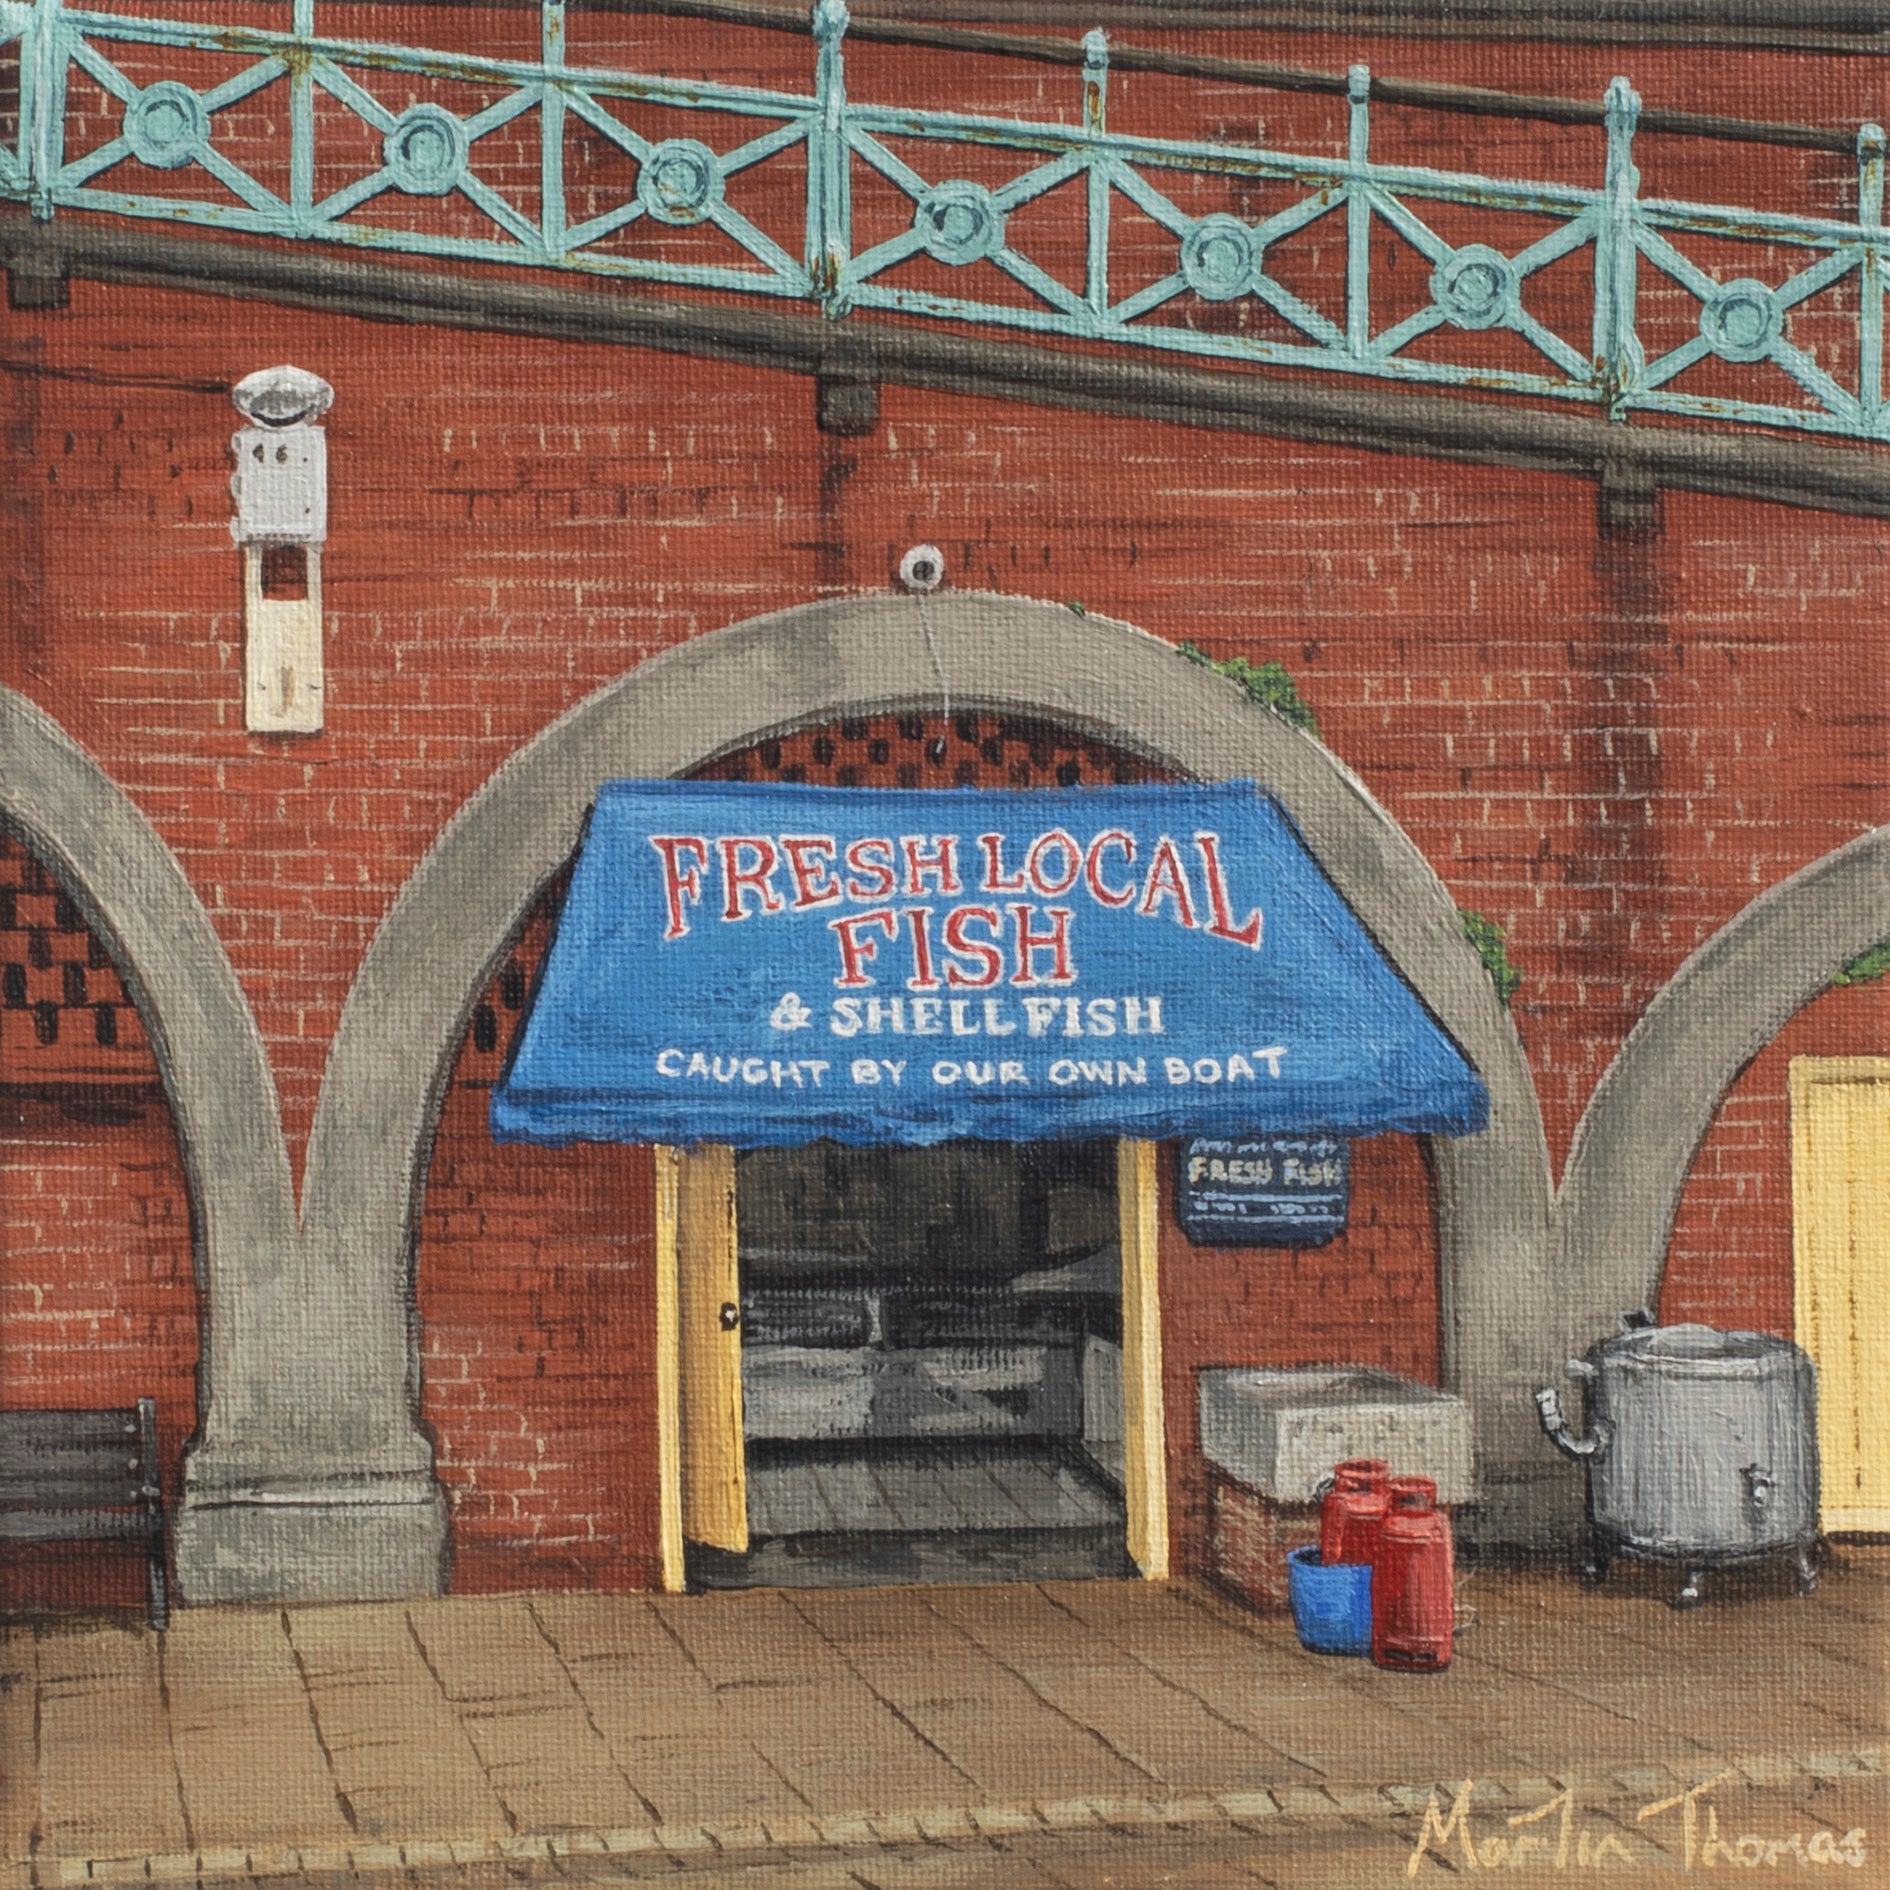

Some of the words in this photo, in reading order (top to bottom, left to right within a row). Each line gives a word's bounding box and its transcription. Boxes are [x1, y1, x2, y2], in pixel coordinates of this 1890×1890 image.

[648, 834, 970, 941] FRESH
[977, 827, 1263, 951] LOCAL
[828, 903, 1078, 990] FISH
[769, 992, 812, 1031] &
[656, 1048, 830, 1088] CAUGHT
[850, 1059, 906, 1085] BY
[932, 1060, 1030, 1086] OUR
[1048, 1057, 1147, 1087] OWN
[1164, 1046, 1288, 1085] BOAT
[1188, 1156, 1273, 1185] FRESH
[1636, 1768, 1867, 1873] Thomas
